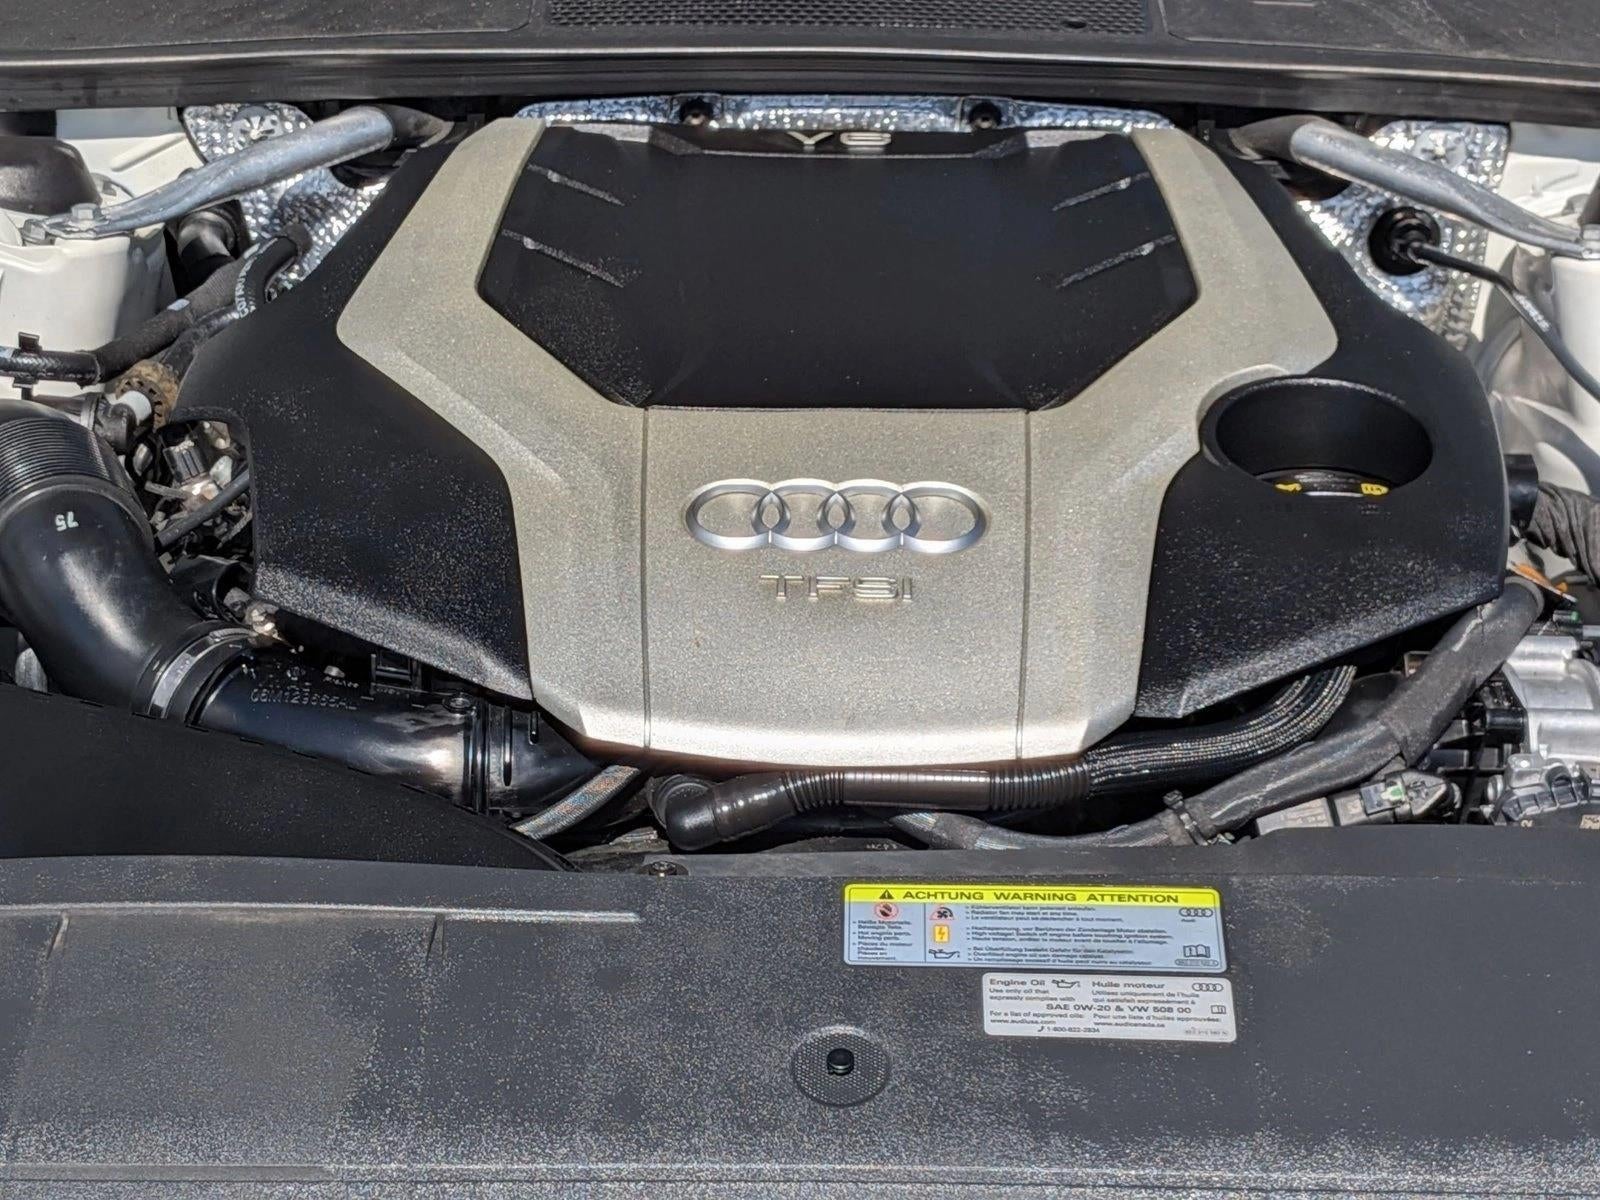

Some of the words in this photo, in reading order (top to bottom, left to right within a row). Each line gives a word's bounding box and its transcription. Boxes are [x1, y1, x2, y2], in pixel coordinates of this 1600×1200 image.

[786, 131, 892, 146] V6
[759, 574, 913, 601] TFSI
[902, 891, 984, 900] ACHTUNG
[993, 892, 1077, 902] WARNING
[1086, 893, 1179, 904] ATTENTION
[989, 979, 1027, 987] Engine
